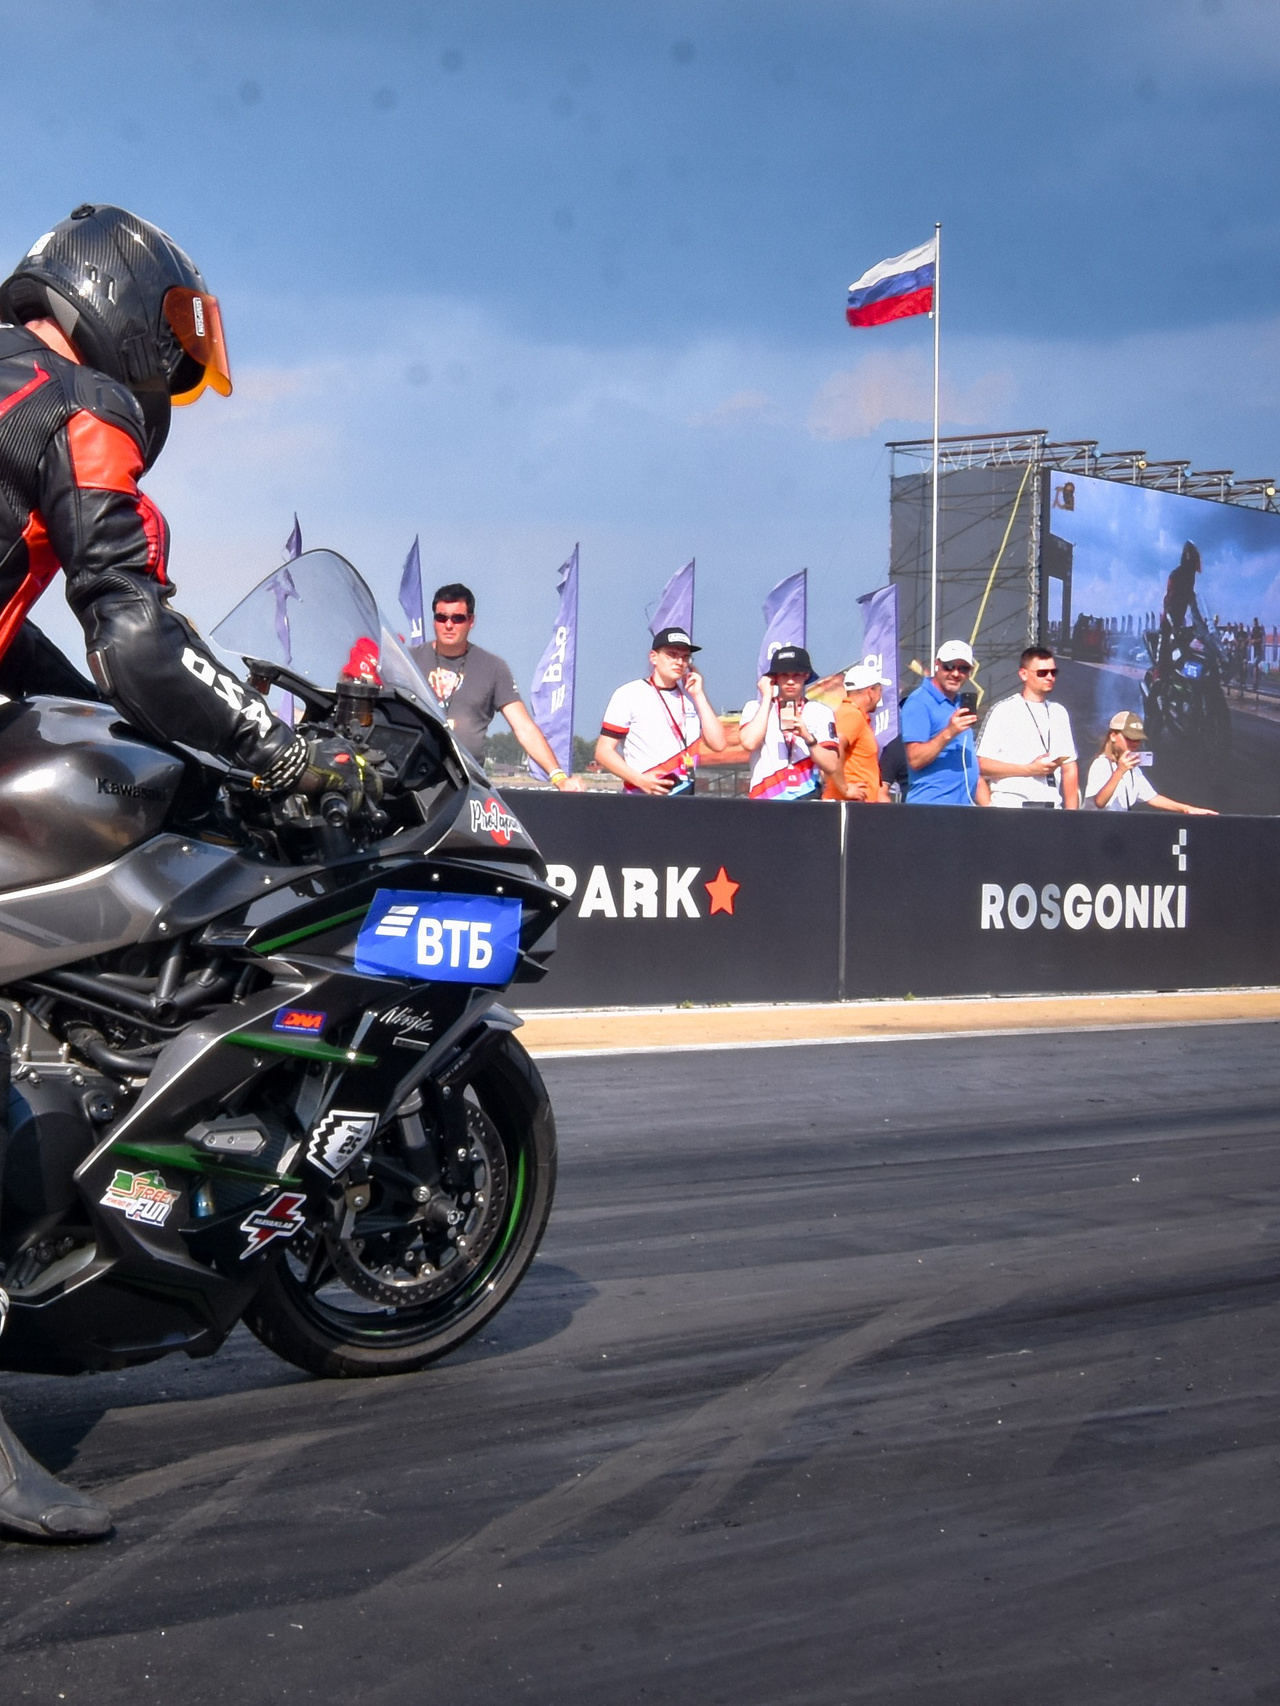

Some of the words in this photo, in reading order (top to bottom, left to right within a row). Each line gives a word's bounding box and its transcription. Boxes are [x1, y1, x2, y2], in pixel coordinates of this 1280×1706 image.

[545, 864, 701, 918] PARK
[980, 882, 1187, 930] ROSGONKI
[416, 917, 493, 970] ВТБ
[379, 1006, 433, 1035] Ninja
[337, 1134, 363, 1155] 25
